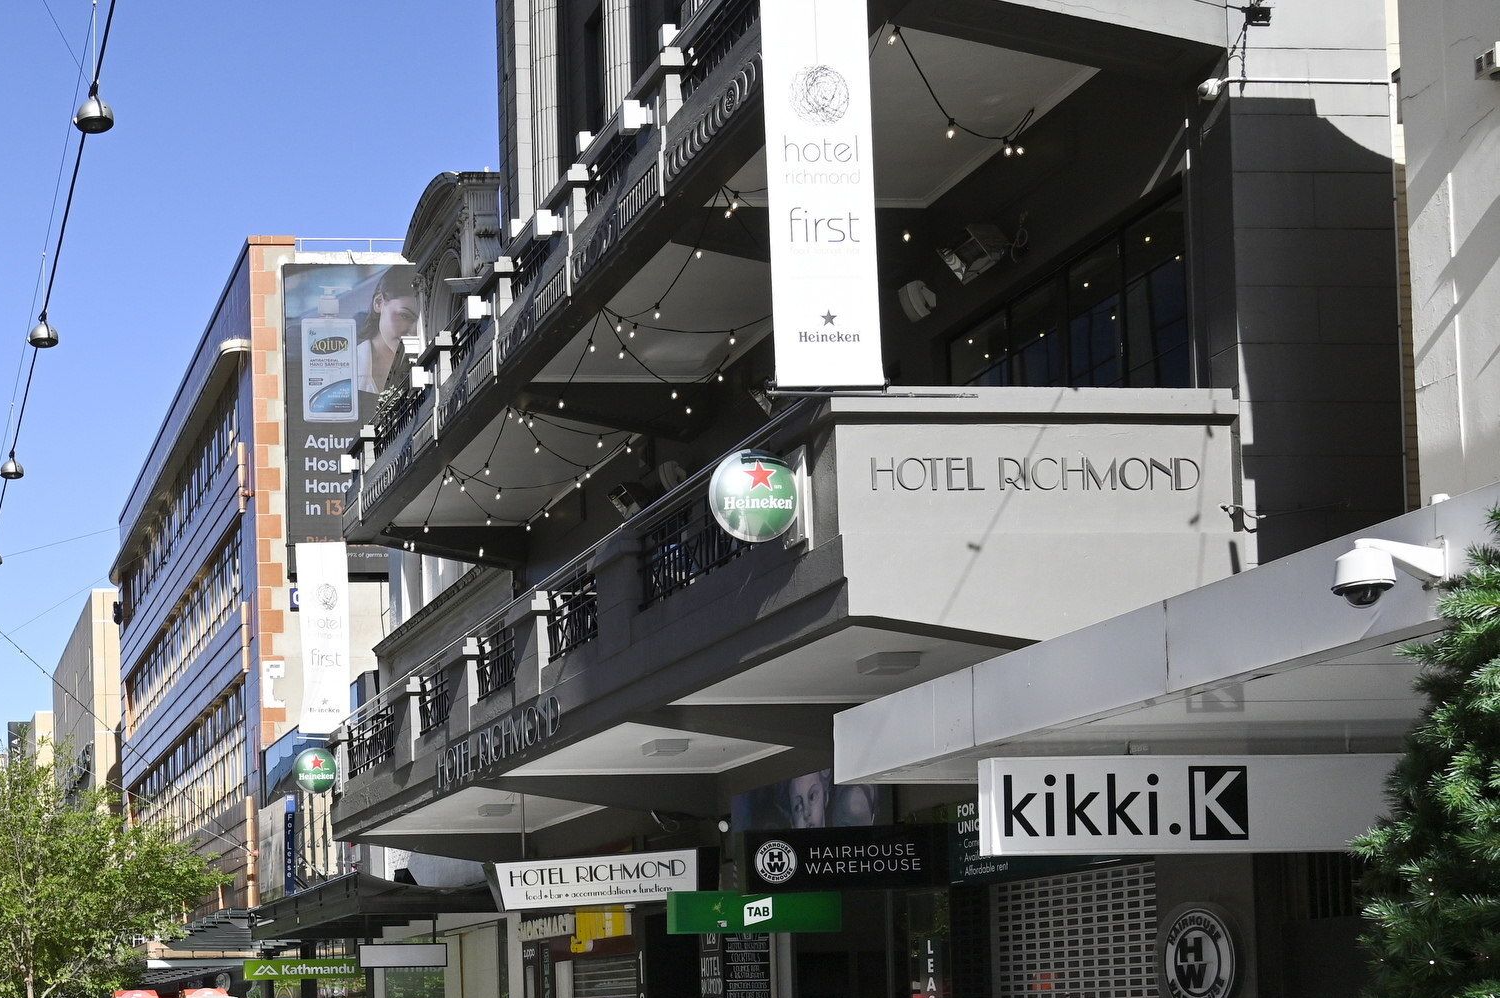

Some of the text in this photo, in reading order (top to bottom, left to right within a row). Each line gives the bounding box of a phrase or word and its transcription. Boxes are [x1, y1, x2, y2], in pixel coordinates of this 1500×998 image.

[784, 135, 859, 162] hotel
[785, 169, 861, 184] richmond
[790, 206, 860, 242] first
[799, 331, 860, 343] Heineken
[869, 456, 1201, 491] HOTEL RICHMOND
[305, 479, 353, 493] Hand
[306, 501, 321, 515] in
[723, 496, 793, 510] Heineken
[311, 648, 342, 667] first
[437, 695, 561, 788] HOTEL RICHMOND
[299, 772, 334, 780] Heineken
[957, 803, 975, 818] FOR
[1003, 767, 1248, 839] kikki.K
[760, 842, 792, 855] HAIRHOUSE
[809, 843, 915, 859] HAIRHOUSE
[509, 859, 686, 887] HOTEL RICHMOND
[804, 858, 922, 874] WAREHOUSE
[964, 862, 1009, 876] Affordable rent
[760, 867, 794, 881] WAREHOUSE
[525, 882, 673, 901] food bar accommodation functions
[746, 906, 770, 917] TAB
[1168, 915, 1222, 946] HAIRHOUSE
[281, 963, 355, 975] Kathmandu
[701, 956, 721, 978] HOTEL
